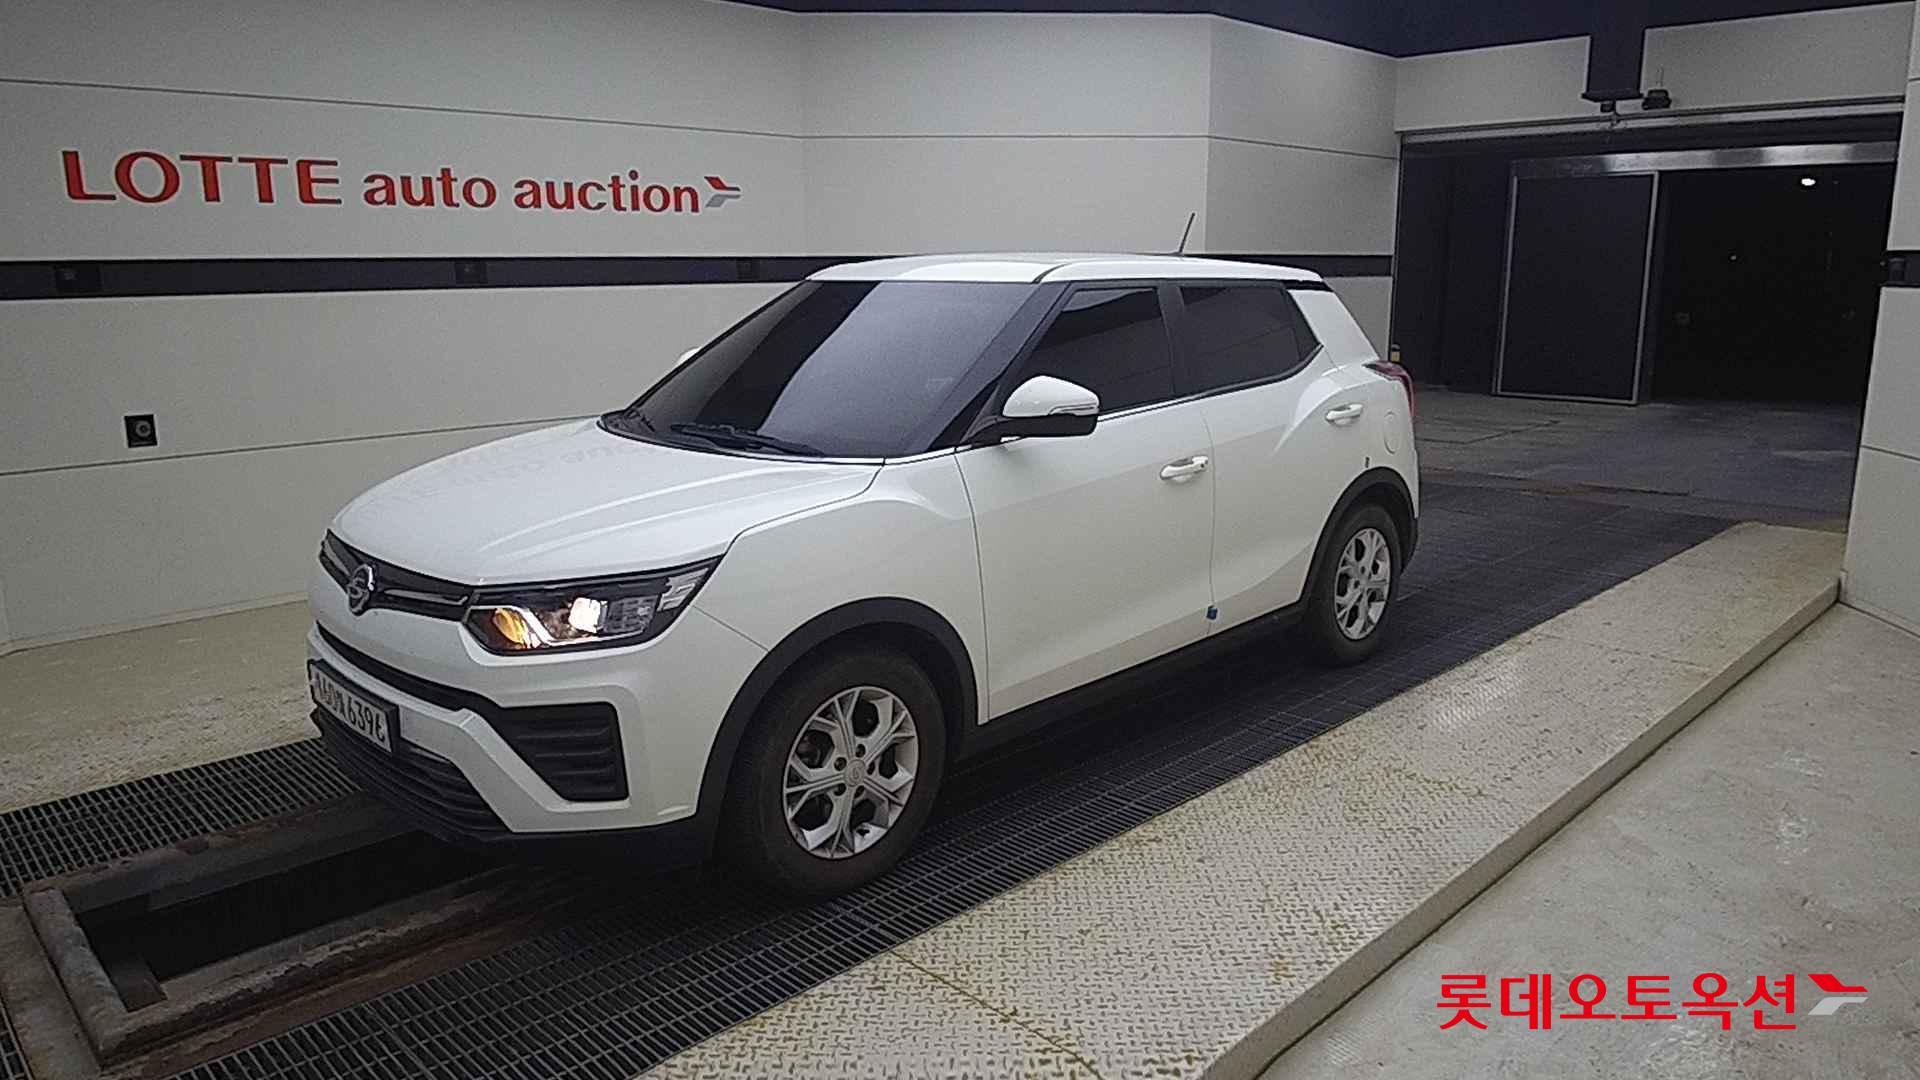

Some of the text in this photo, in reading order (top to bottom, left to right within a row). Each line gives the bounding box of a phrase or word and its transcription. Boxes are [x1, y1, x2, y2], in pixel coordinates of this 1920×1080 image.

[62, 150, 700, 213] LOTTE auto auction
